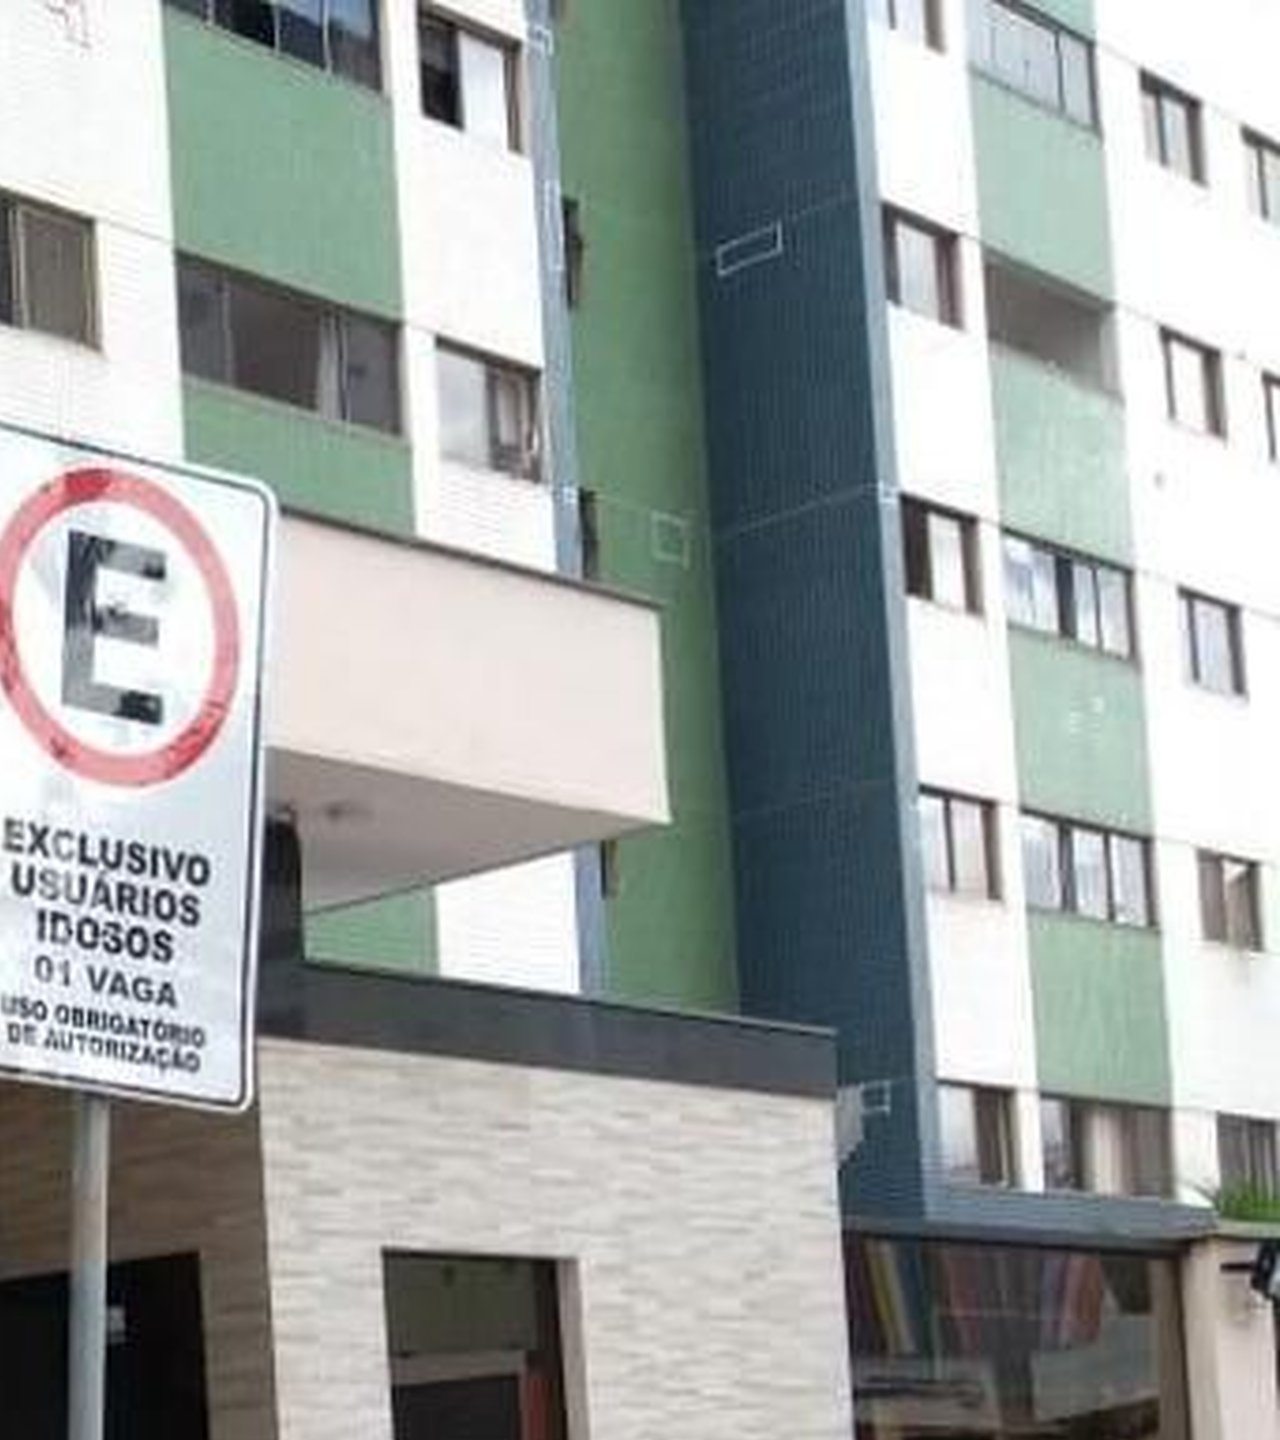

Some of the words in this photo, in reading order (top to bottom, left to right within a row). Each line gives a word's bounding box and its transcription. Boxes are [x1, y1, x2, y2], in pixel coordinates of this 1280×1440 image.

[60, 528, 166, 725] E
[2, 816, 210, 887] EXCLUSIVO
[11, 860, 202, 928] USUÁRIOS
[36, 907, 174, 964] IDOSOS
[34, 954, 71, 987] 01
[86, 965, 178, 1009] VAGA
[0, 993, 49, 1021] USO
[54, 1003, 207, 1049] OBRIGATÓRIO
[7, 1022, 39, 1046] DE
